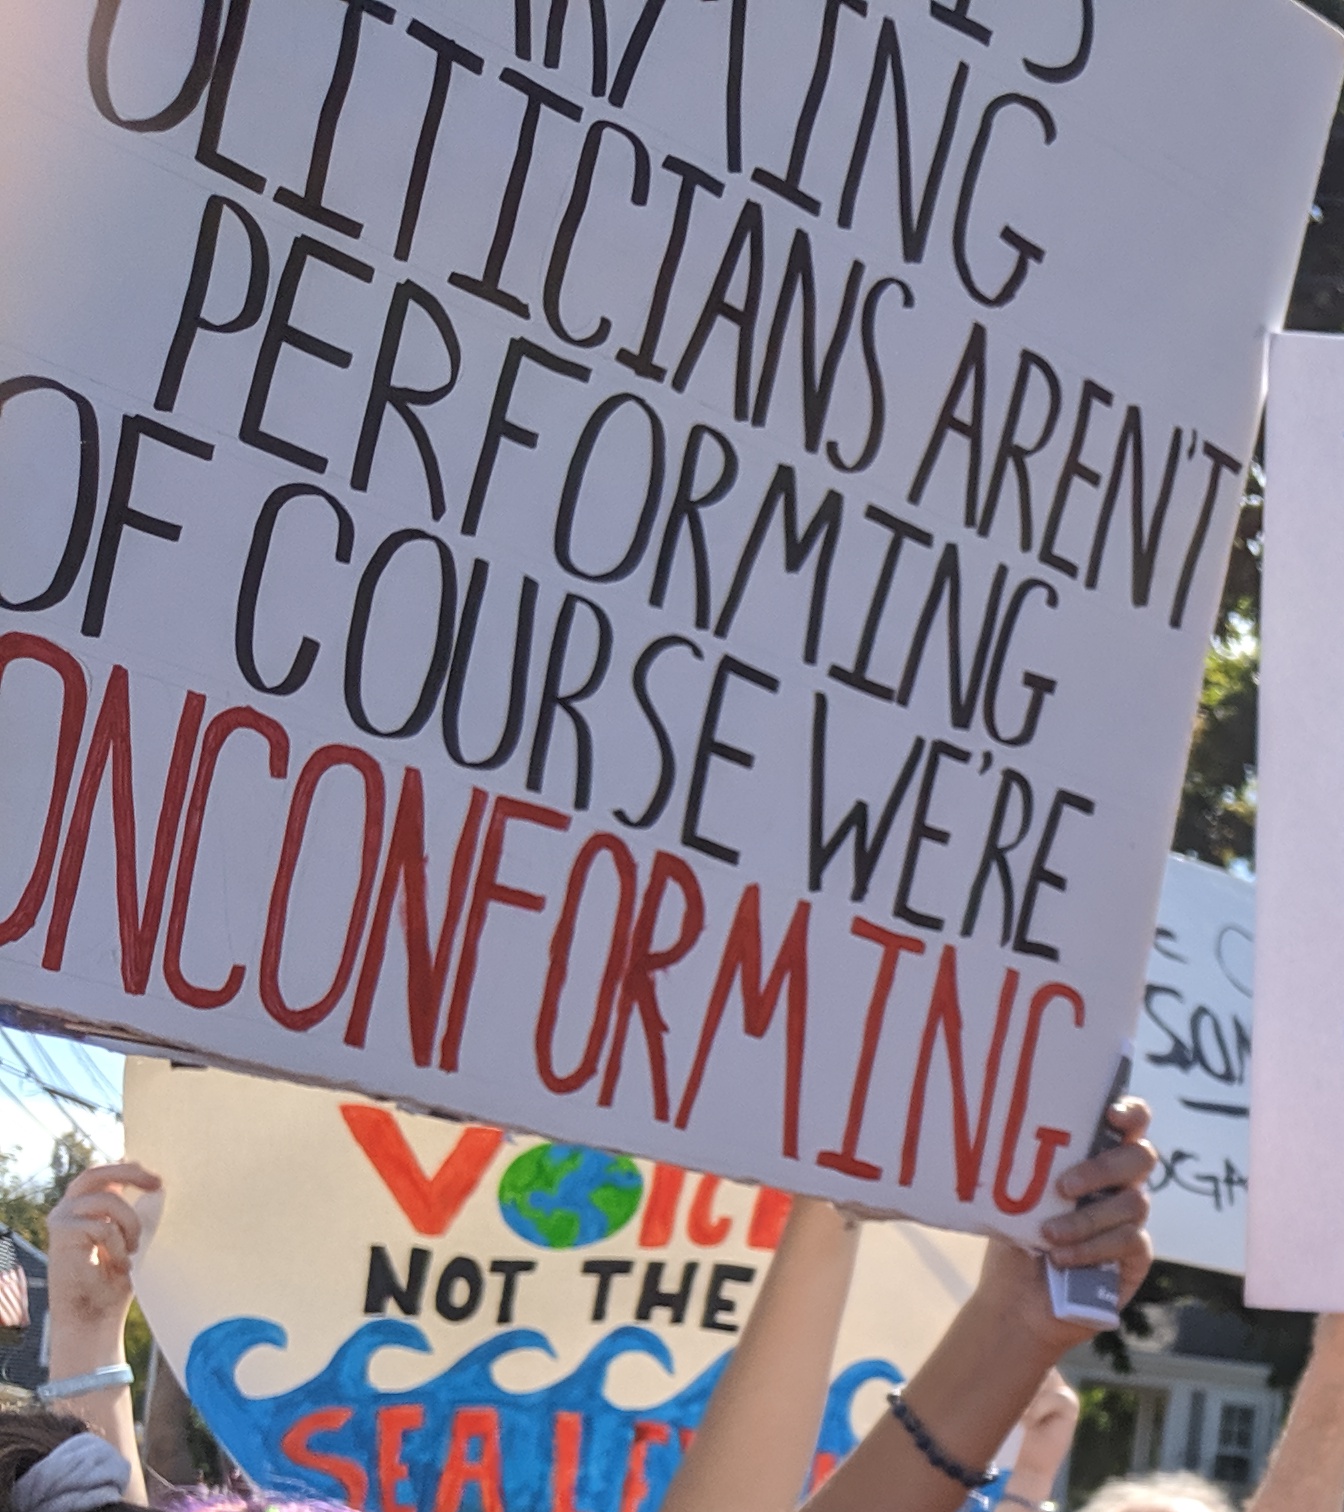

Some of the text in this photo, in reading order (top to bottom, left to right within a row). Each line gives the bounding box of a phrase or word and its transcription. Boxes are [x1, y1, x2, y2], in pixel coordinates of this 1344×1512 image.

[88, 0, 1242, 628] OLITICIANS AREN'T
[155, 194, 1060, 746] PERFORMING
[0, 375, 1096, 961] OF COURSE WE'RE
[0, 632, 1086, 1215] ONCONFORMING
[364, 1245, 537, 1324] NOT
[581, 1259, 756, 1332] THE
